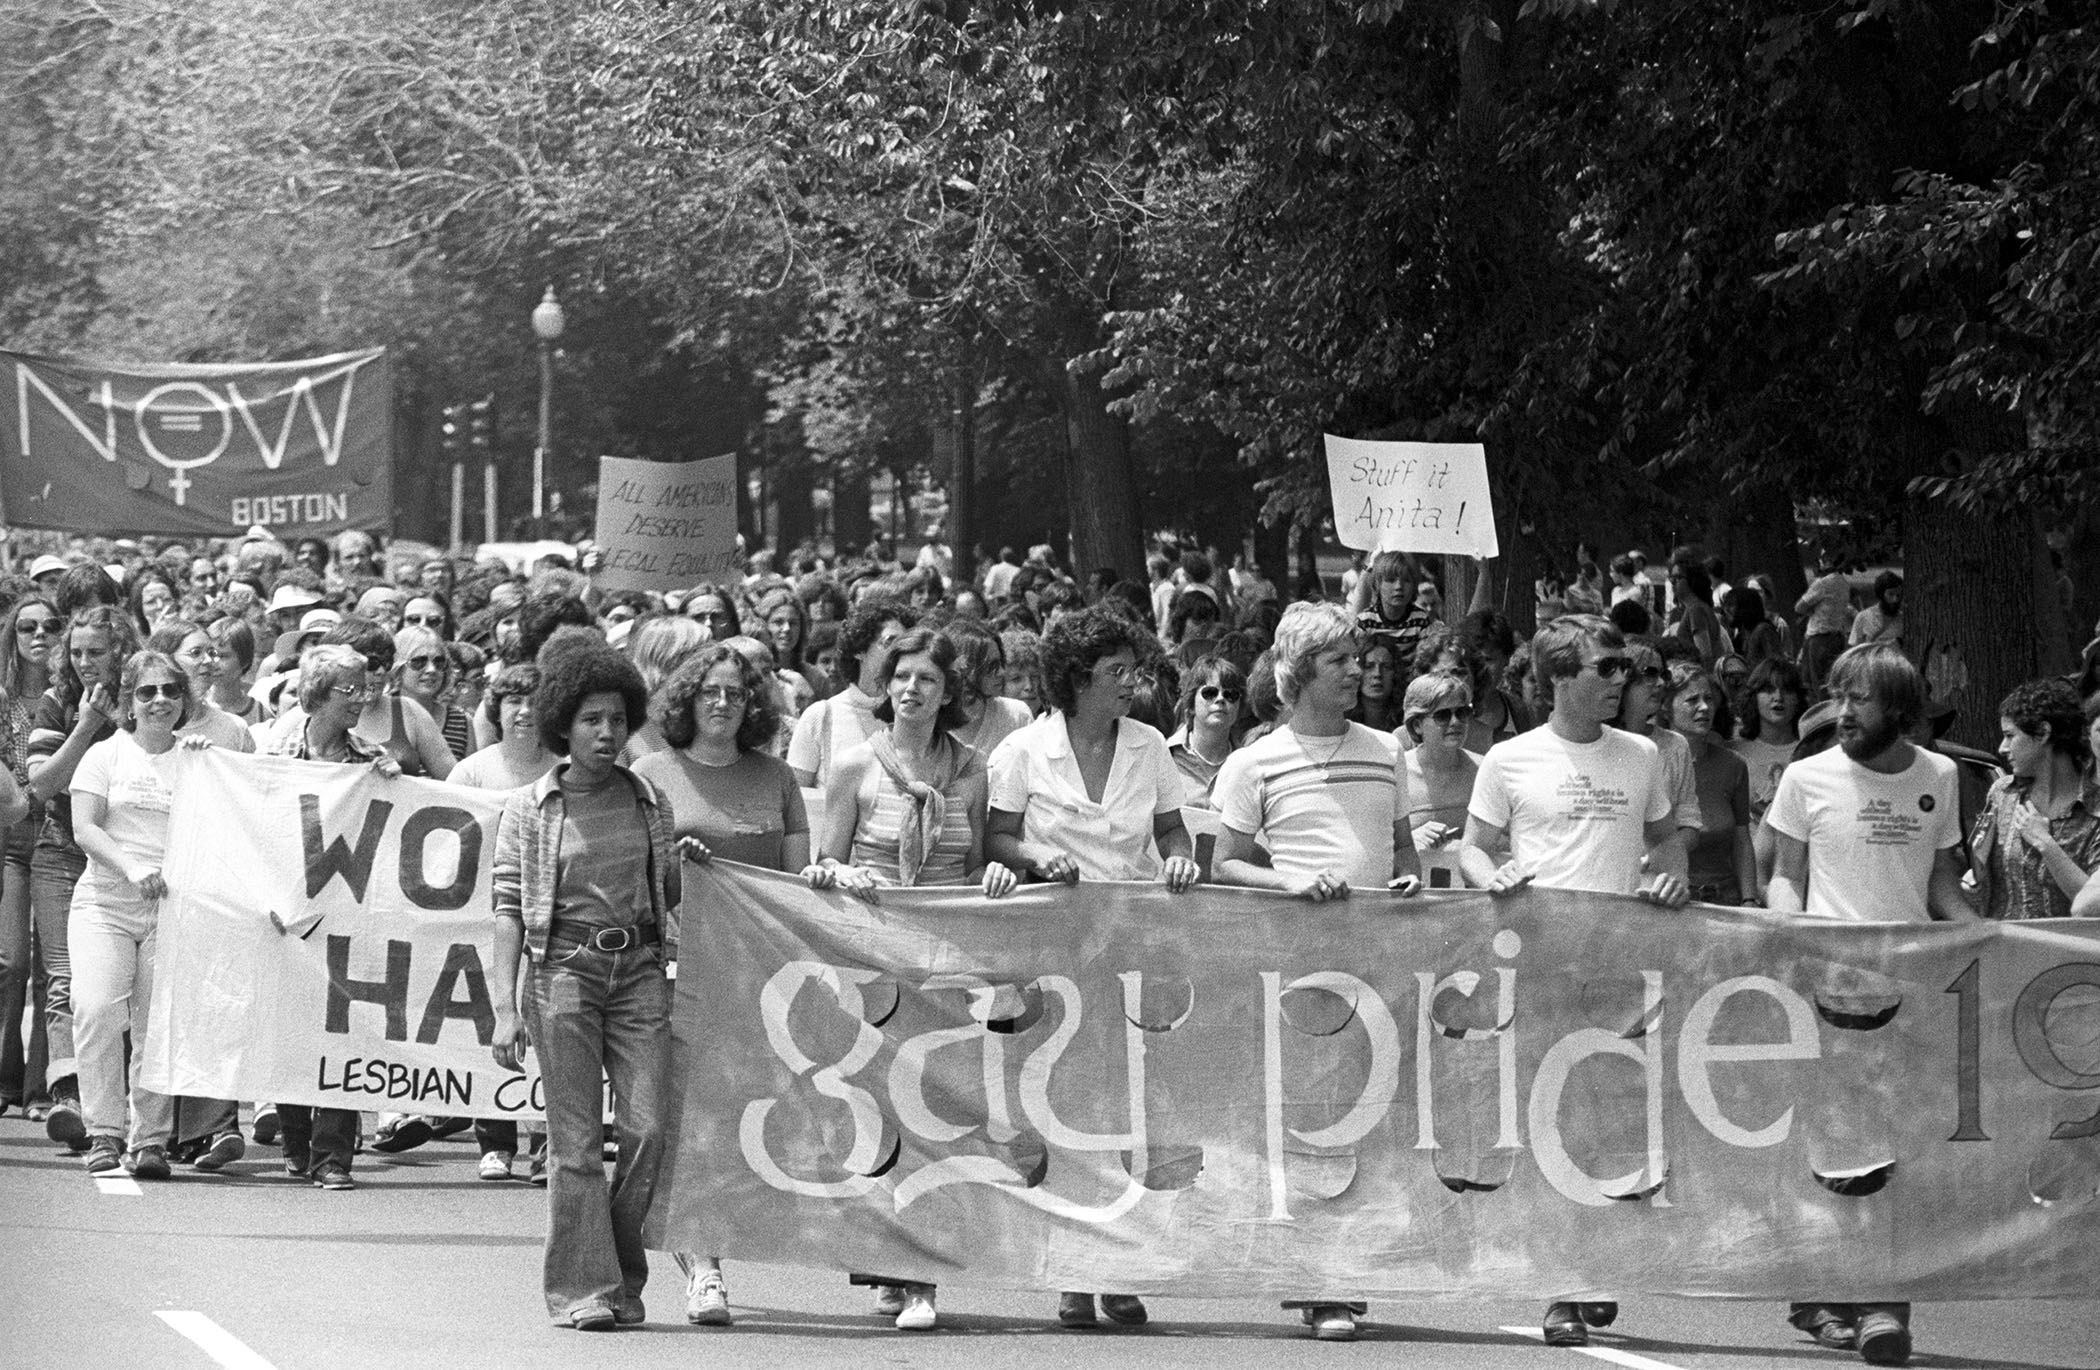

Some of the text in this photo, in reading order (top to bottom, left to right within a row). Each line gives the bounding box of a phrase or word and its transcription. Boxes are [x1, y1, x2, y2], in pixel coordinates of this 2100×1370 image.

[17, 363, 355, 469] NOW
[611, 480, 646, 505] ALL
[1350, 457, 1451, 489] Stuff it
[232, 494, 347, 526] BOSTON
[624, 512, 706, 538] DESERVE
[602, 547, 659, 573] LEGAL
[300, 794, 504, 912] WO
[325, 934, 531, 1047] HA
[319, 1056, 472, 1106] LESBIAN
[739, 961, 1148, 1223] gay
[1259, 930, 1821, 1221] pride
